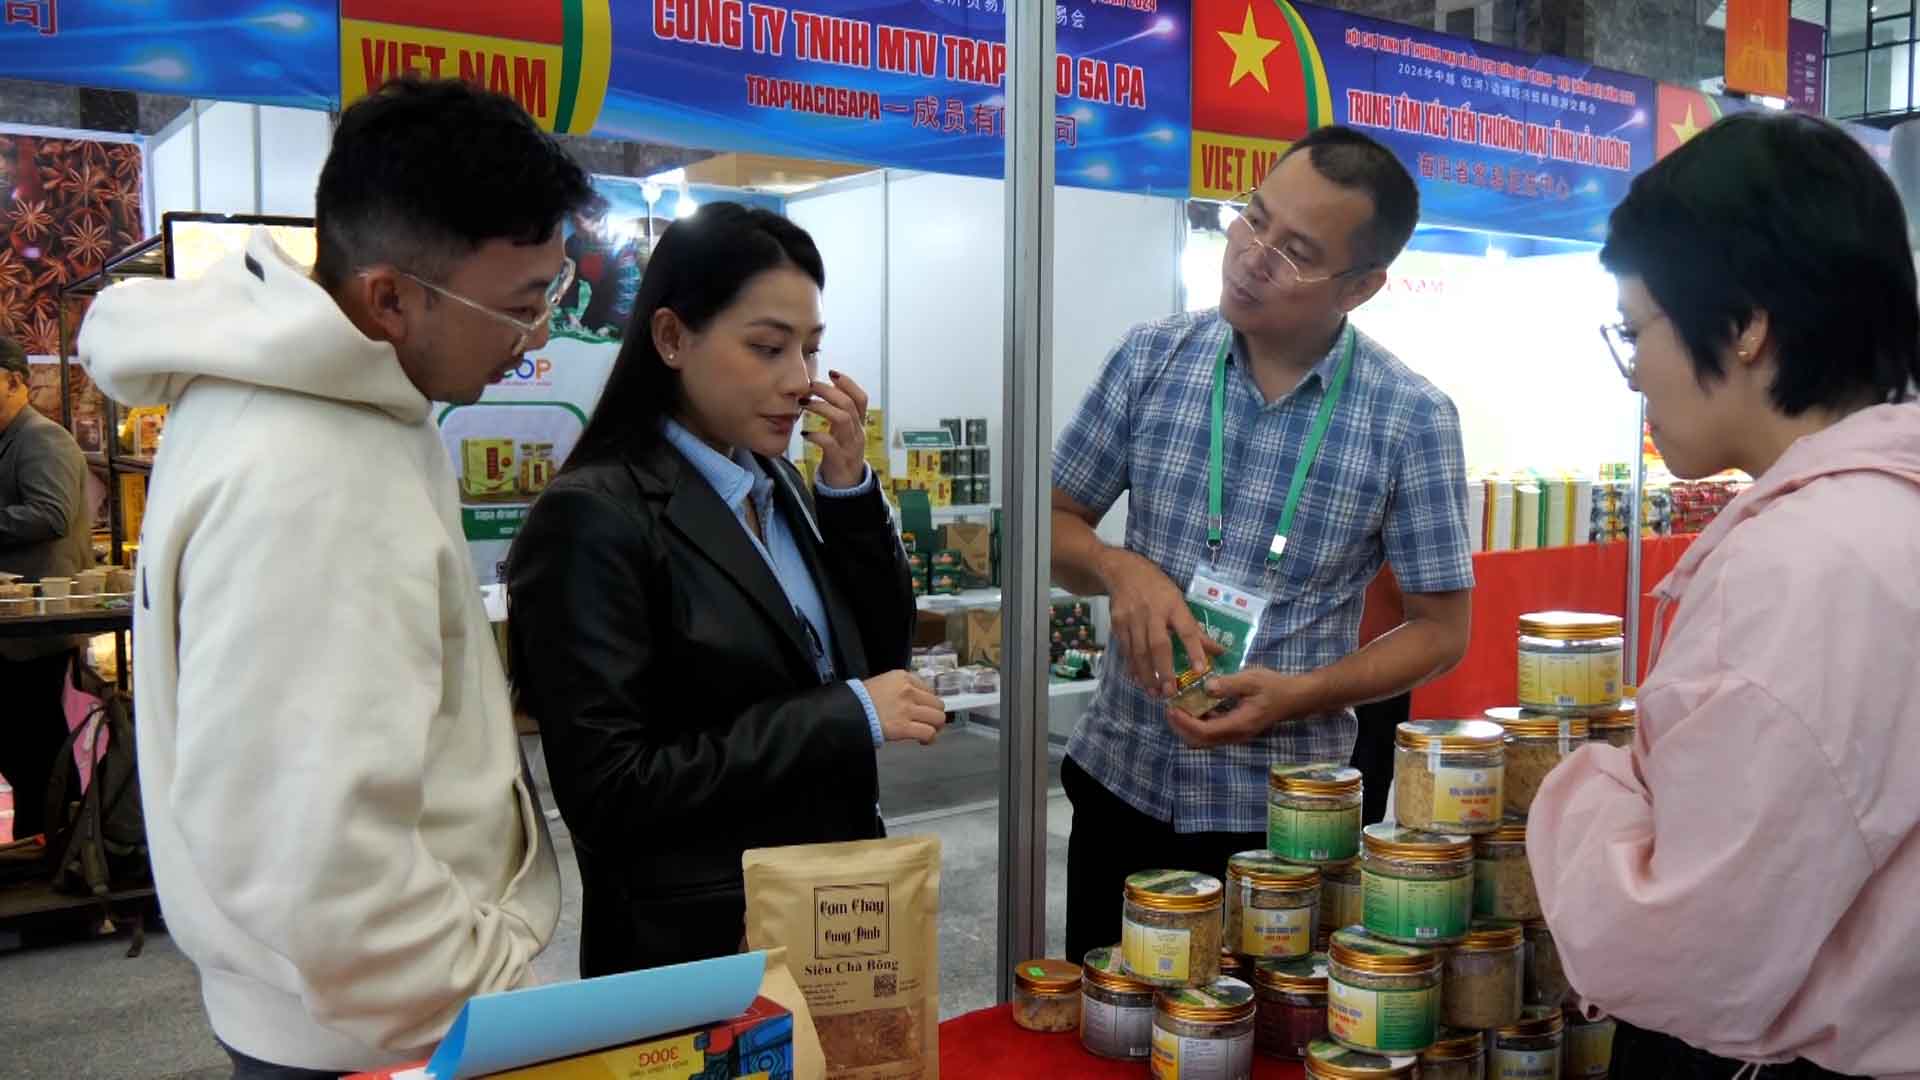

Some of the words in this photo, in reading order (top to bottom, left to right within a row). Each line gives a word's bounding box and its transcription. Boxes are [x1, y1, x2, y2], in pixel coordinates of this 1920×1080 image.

[458, 48, 547, 118] NAM
[749, 4, 787, 56] TY
[791, 10, 870, 69] TNHH
[876, 24, 938, 78] MTV
[1078, 56, 1111, 105] SA
[1113, 63, 1147, 110] PA
[744, 73, 882, 121] TRAPHACOSAPA
[1346, 88, 1392, 130] TRUNG
[1394, 91, 1422, 137] TÂM
[1423, 98, 1449, 140] XÚC
[1478, 113, 1524, 153] THƯƠNG
[1526, 122, 1547, 165] MẠI
[1549, 119, 1575, 162] TỈNH
[1576, 124, 1594, 166] HẢI
[1201, 142, 1249, 193] VIET
